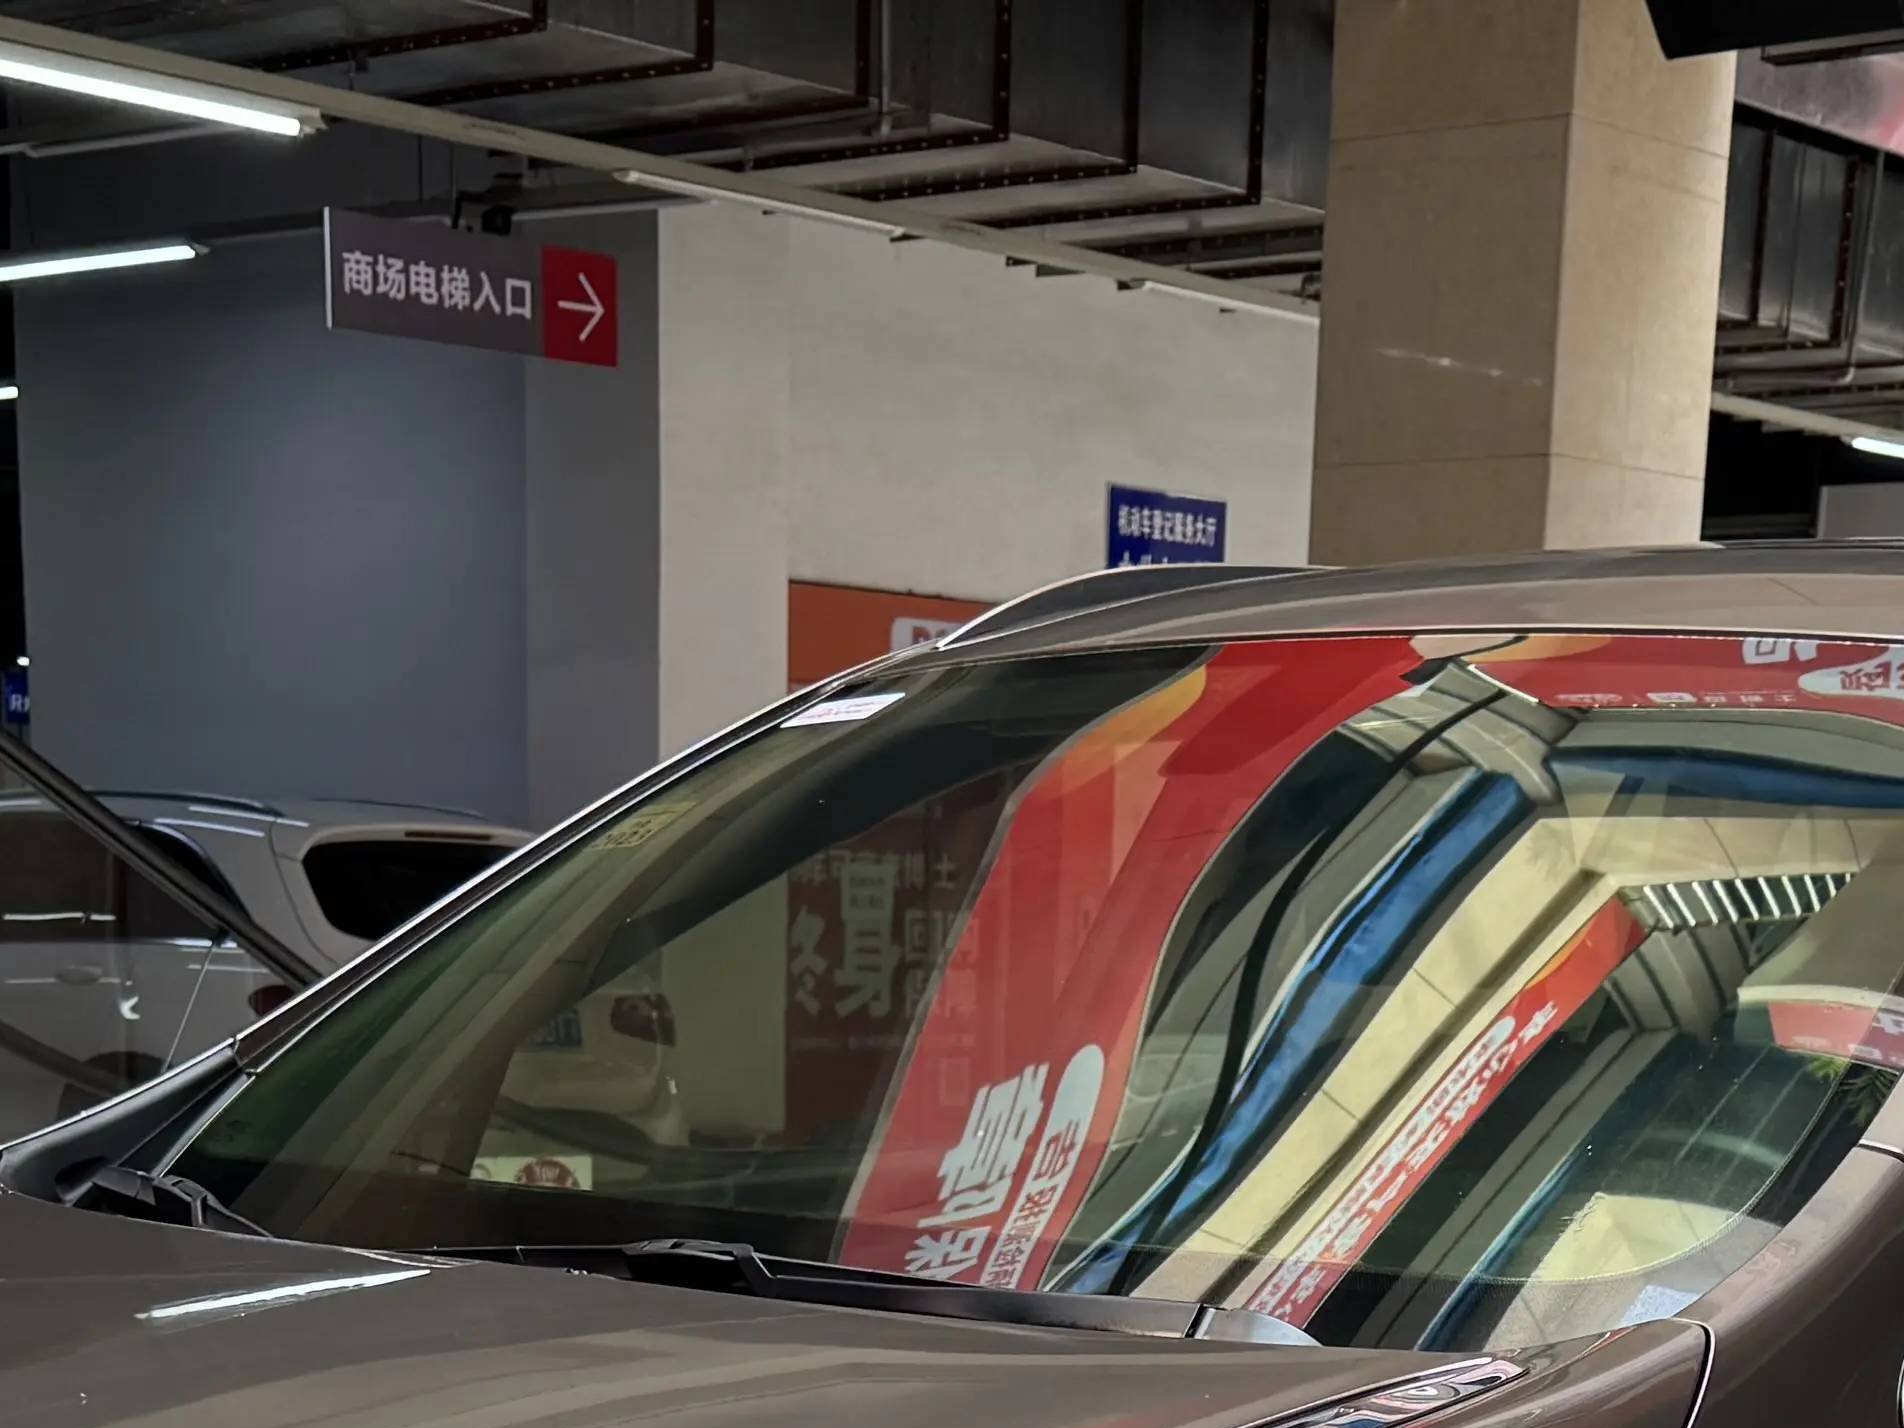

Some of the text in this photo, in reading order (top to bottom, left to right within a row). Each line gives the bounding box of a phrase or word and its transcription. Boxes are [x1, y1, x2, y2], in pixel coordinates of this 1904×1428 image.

[342, 250, 533, 320] 商场电梯入口
